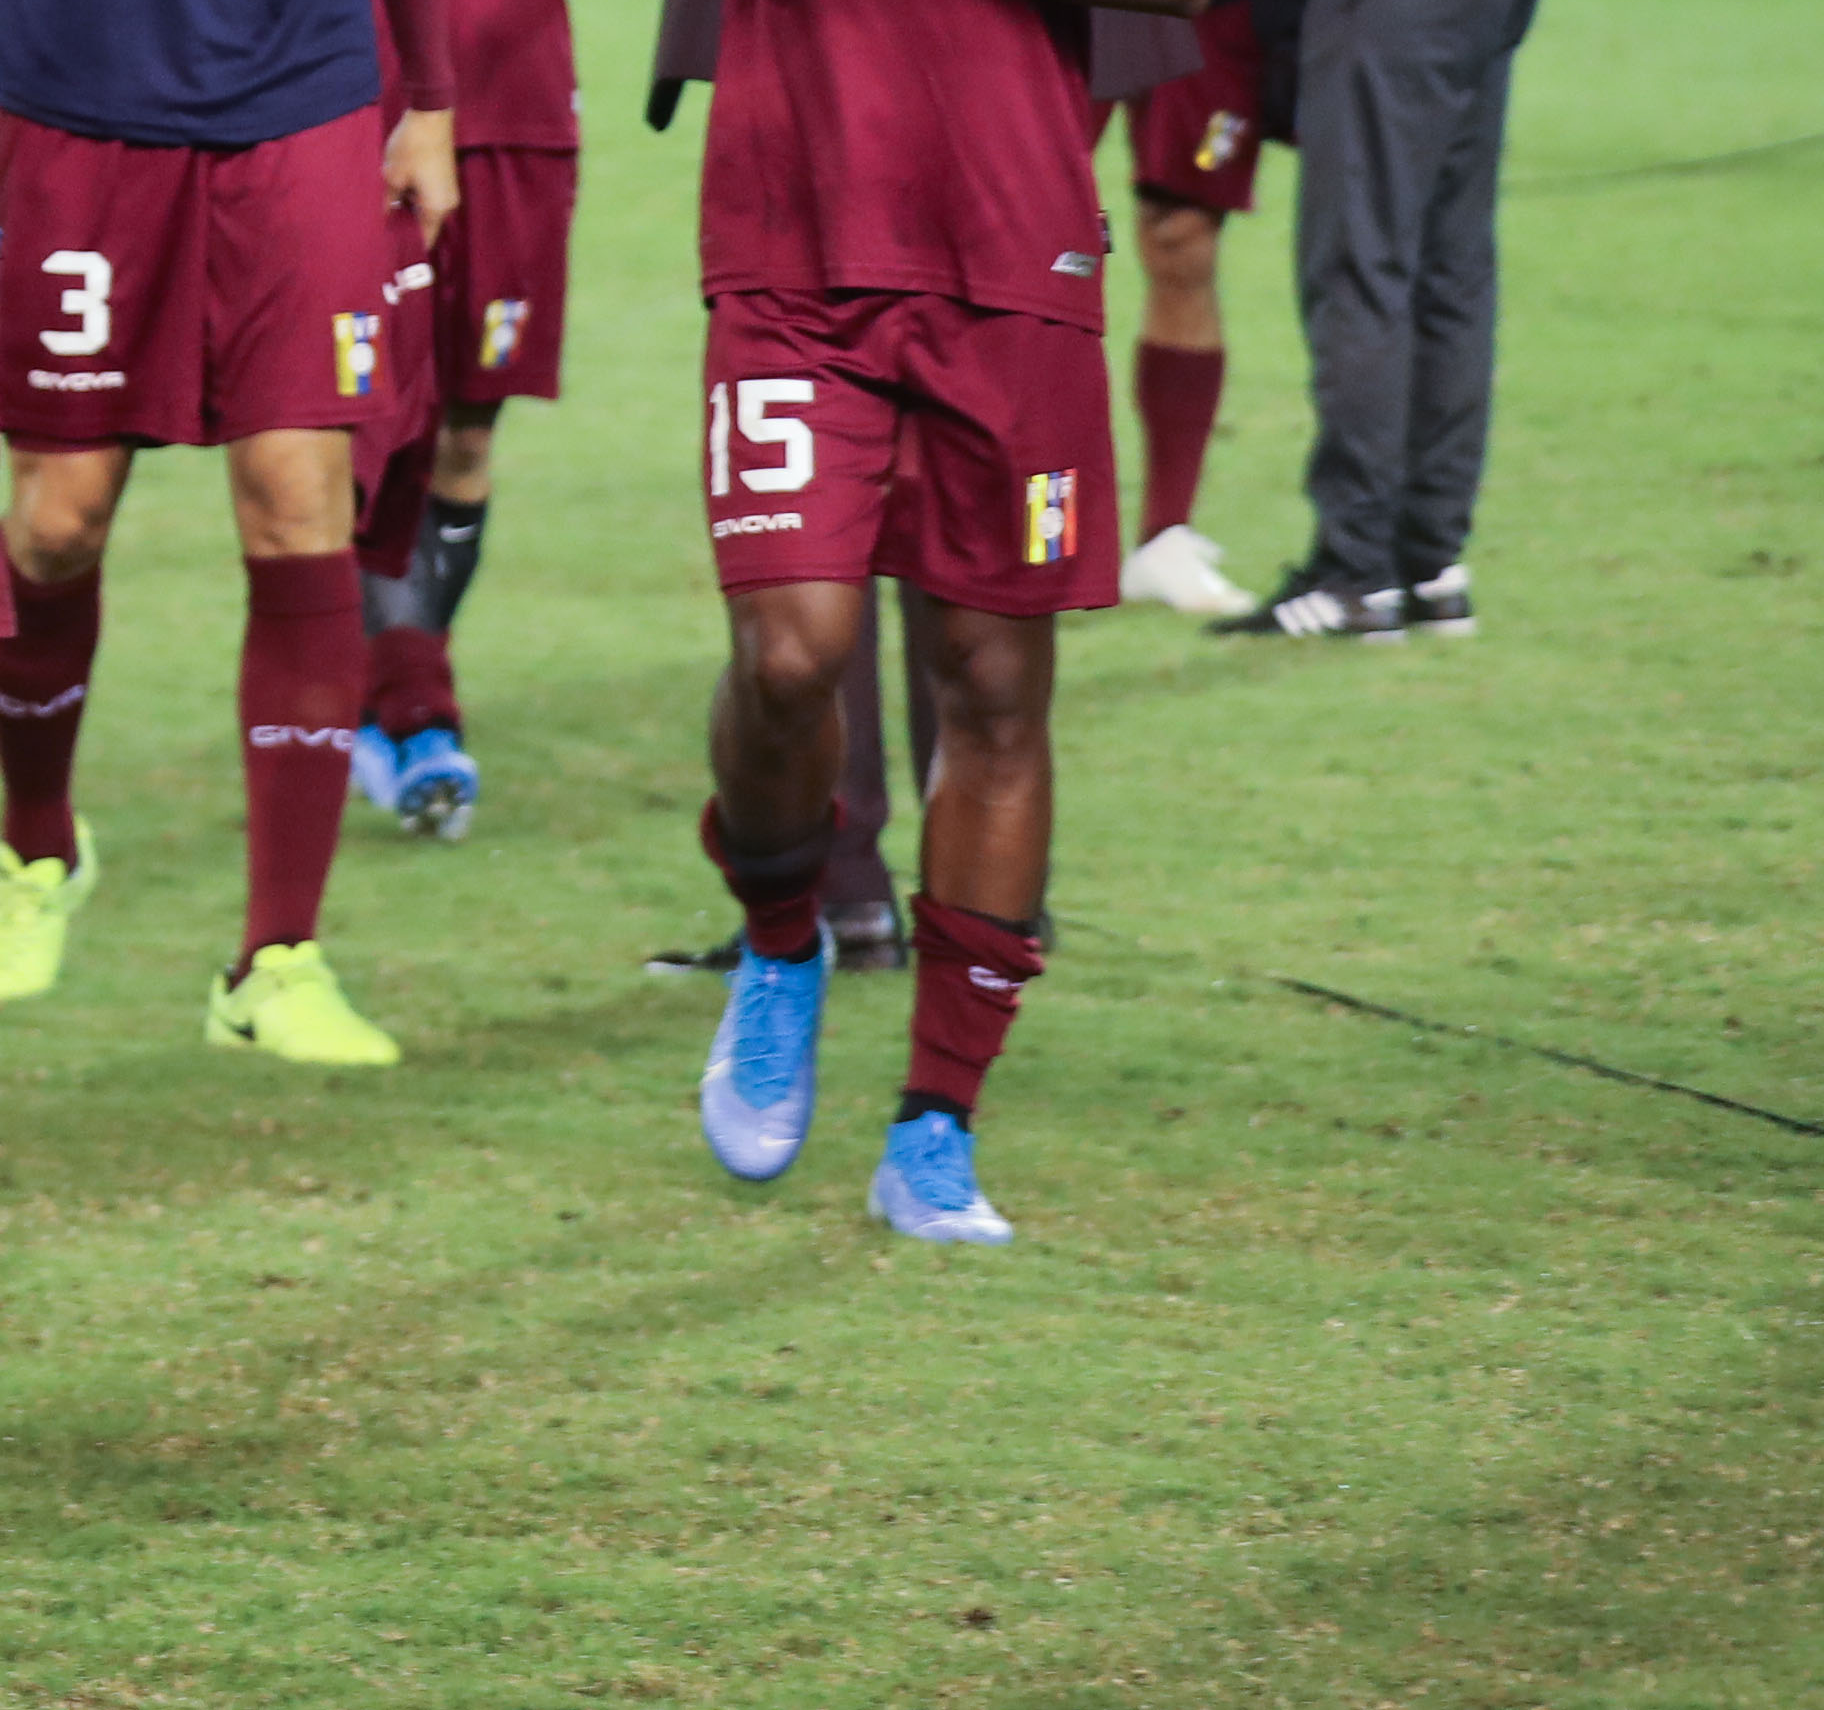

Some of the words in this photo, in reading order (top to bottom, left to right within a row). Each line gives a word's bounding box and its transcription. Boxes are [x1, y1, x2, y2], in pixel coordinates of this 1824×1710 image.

[39, 249, 113, 357] 3
[711, 378, 814, 496] 15
[711, 511, 804, 540] GIVOVA
